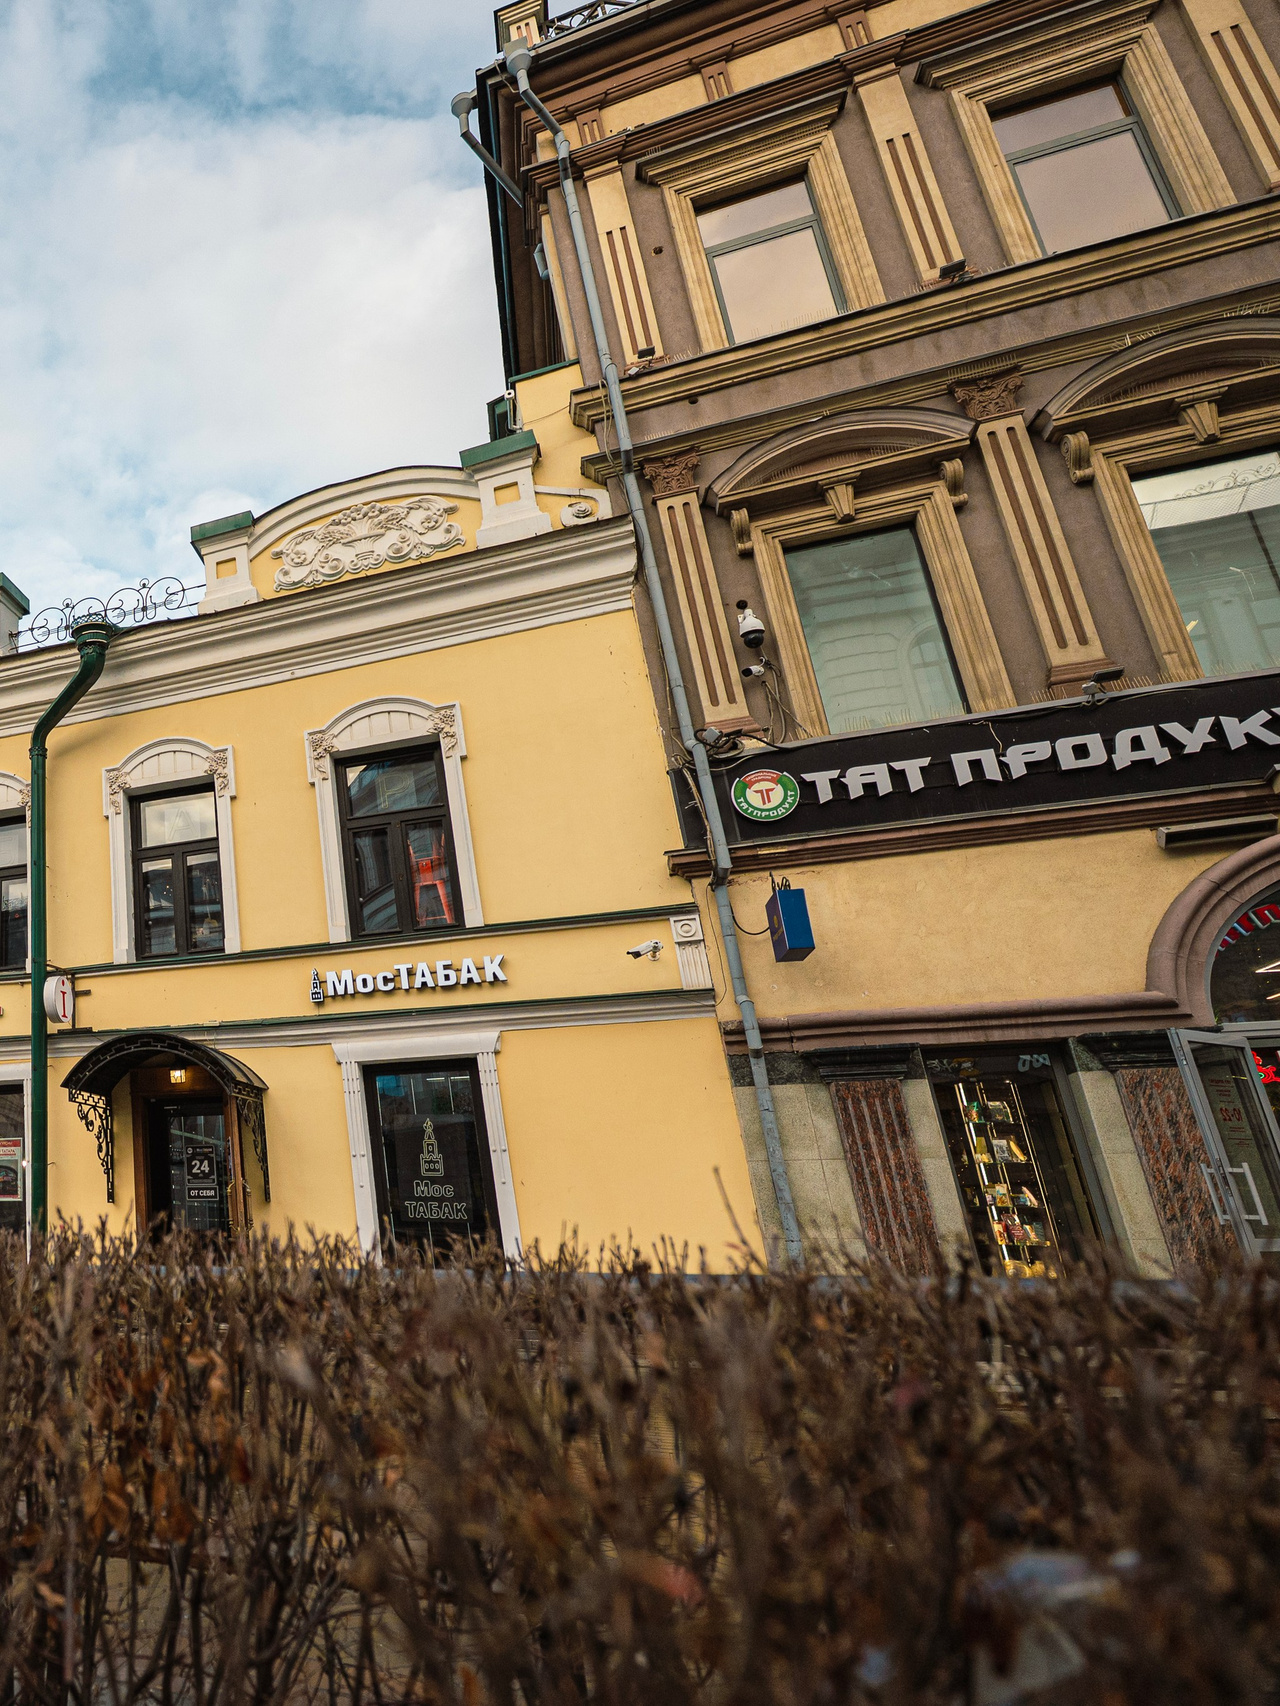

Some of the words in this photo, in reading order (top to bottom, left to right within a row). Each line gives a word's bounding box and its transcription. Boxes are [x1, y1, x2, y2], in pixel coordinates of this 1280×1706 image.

[800, 756, 932, 804] ТАТ
[949, 706, 1280, 787] ПРОДУК
[737, 790, 795, 818] ТАТПРОДУКТ
[325, 954, 508, 997] МосТАБАК
[191, 1160, 210, 1174] 24
[413, 1180, 455, 1198] Мос
[404, 1201, 468, 1220] ТАБАК
